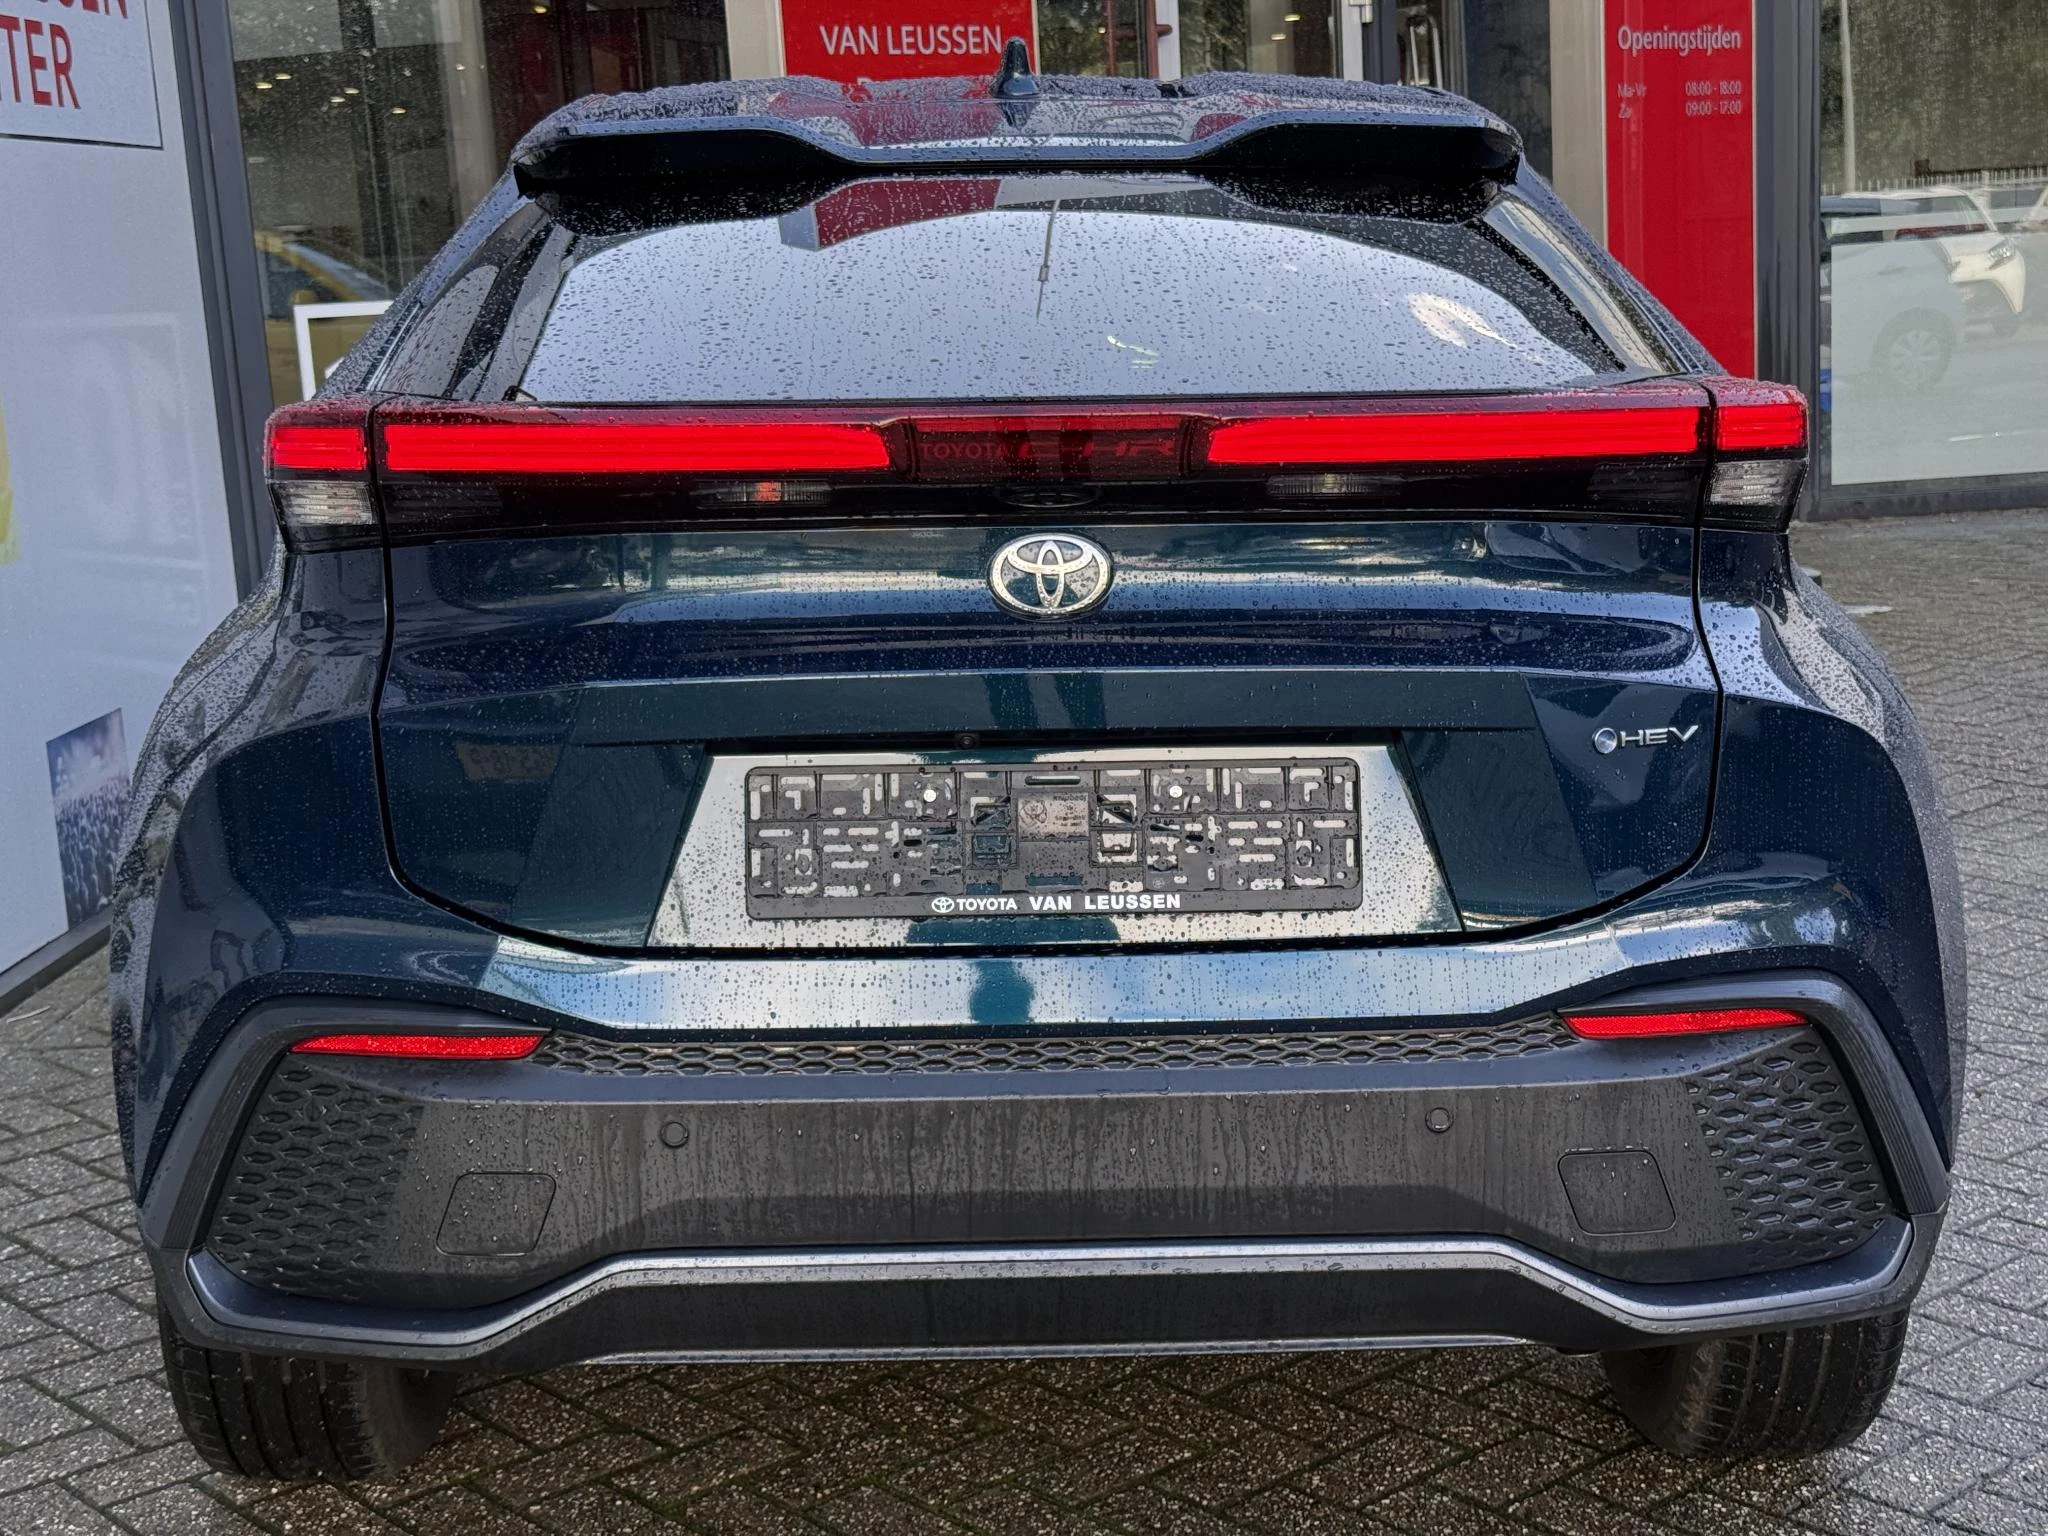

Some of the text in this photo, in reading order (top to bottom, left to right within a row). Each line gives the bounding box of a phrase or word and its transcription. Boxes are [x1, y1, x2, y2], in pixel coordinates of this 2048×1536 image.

[819, 24, 1002, 55] VAN LEUSSEN
[1617, 25, 1742, 57] Openingstijden
[0, 14, 81, 109] TER
[921, 443, 1009, 460] TOYOTA
[1620, 725, 1699, 747] HEV
[956, 894, 1181, 911] TOYOTA VAN LEUSSEN
